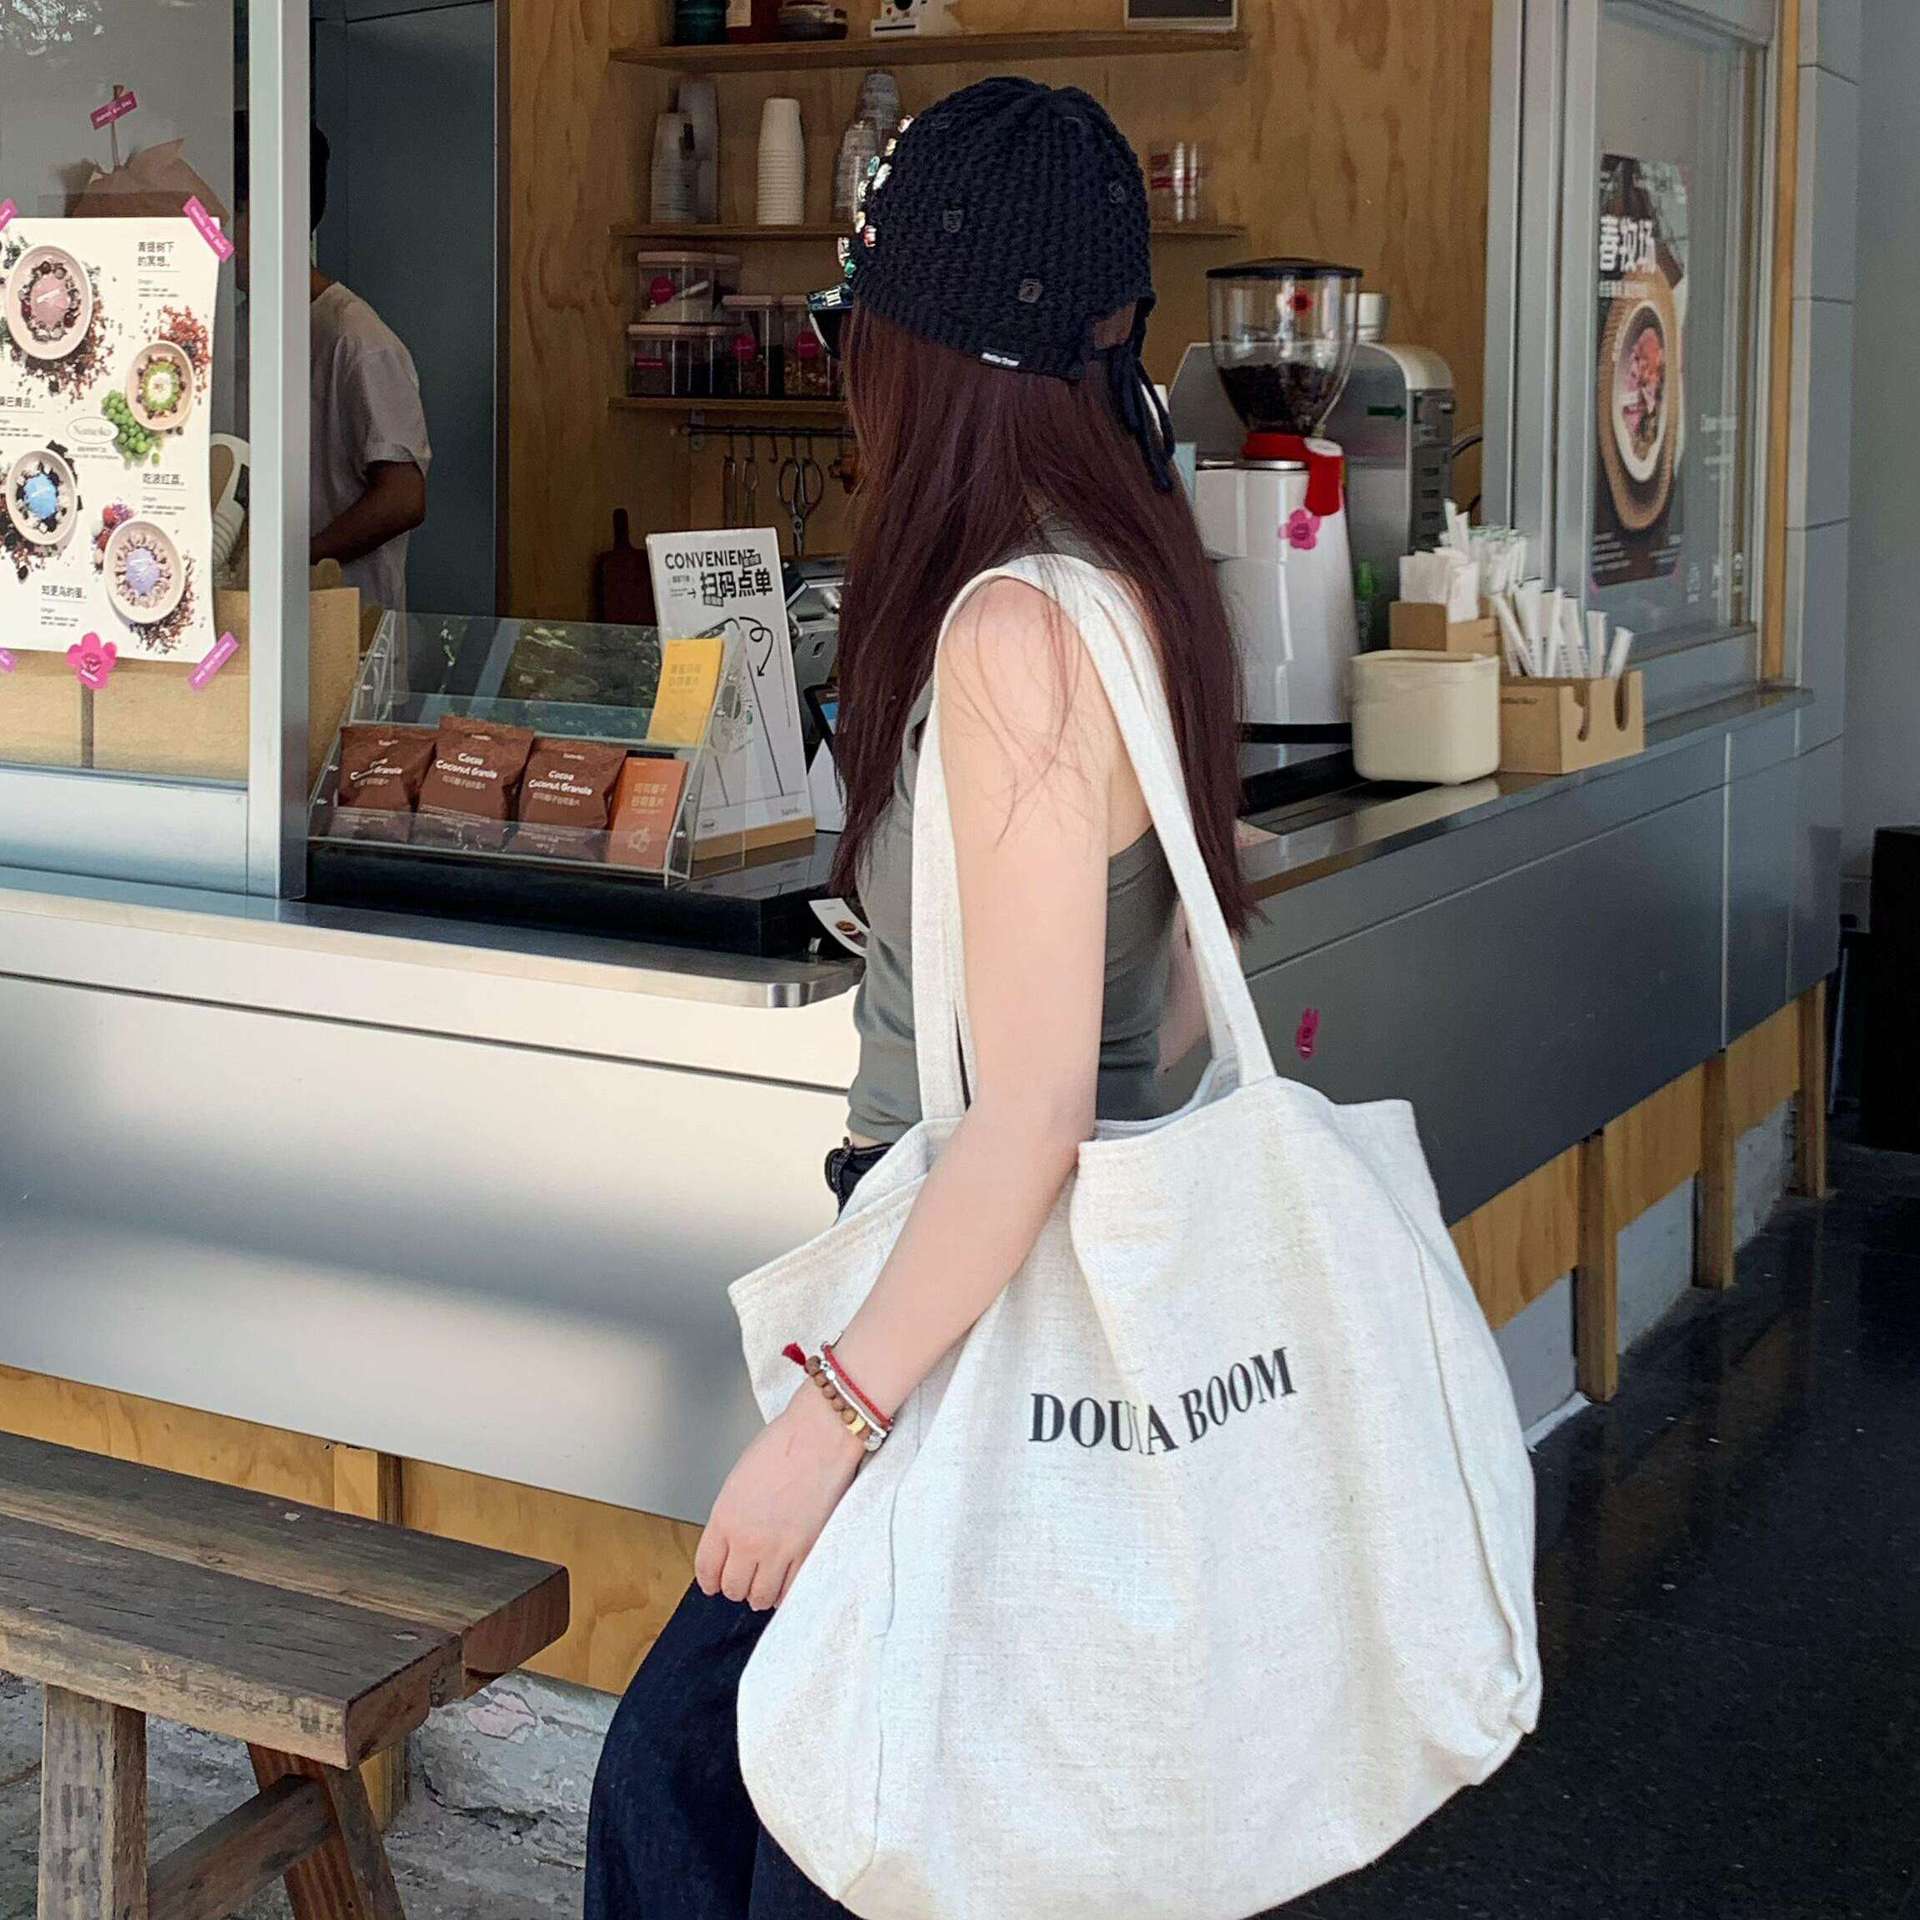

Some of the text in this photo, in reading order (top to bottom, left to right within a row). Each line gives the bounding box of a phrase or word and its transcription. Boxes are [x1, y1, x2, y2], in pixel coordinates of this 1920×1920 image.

[700, 568, 773, 598] 扫码点单
[1178, 1346, 1298, 1444] BOOM
